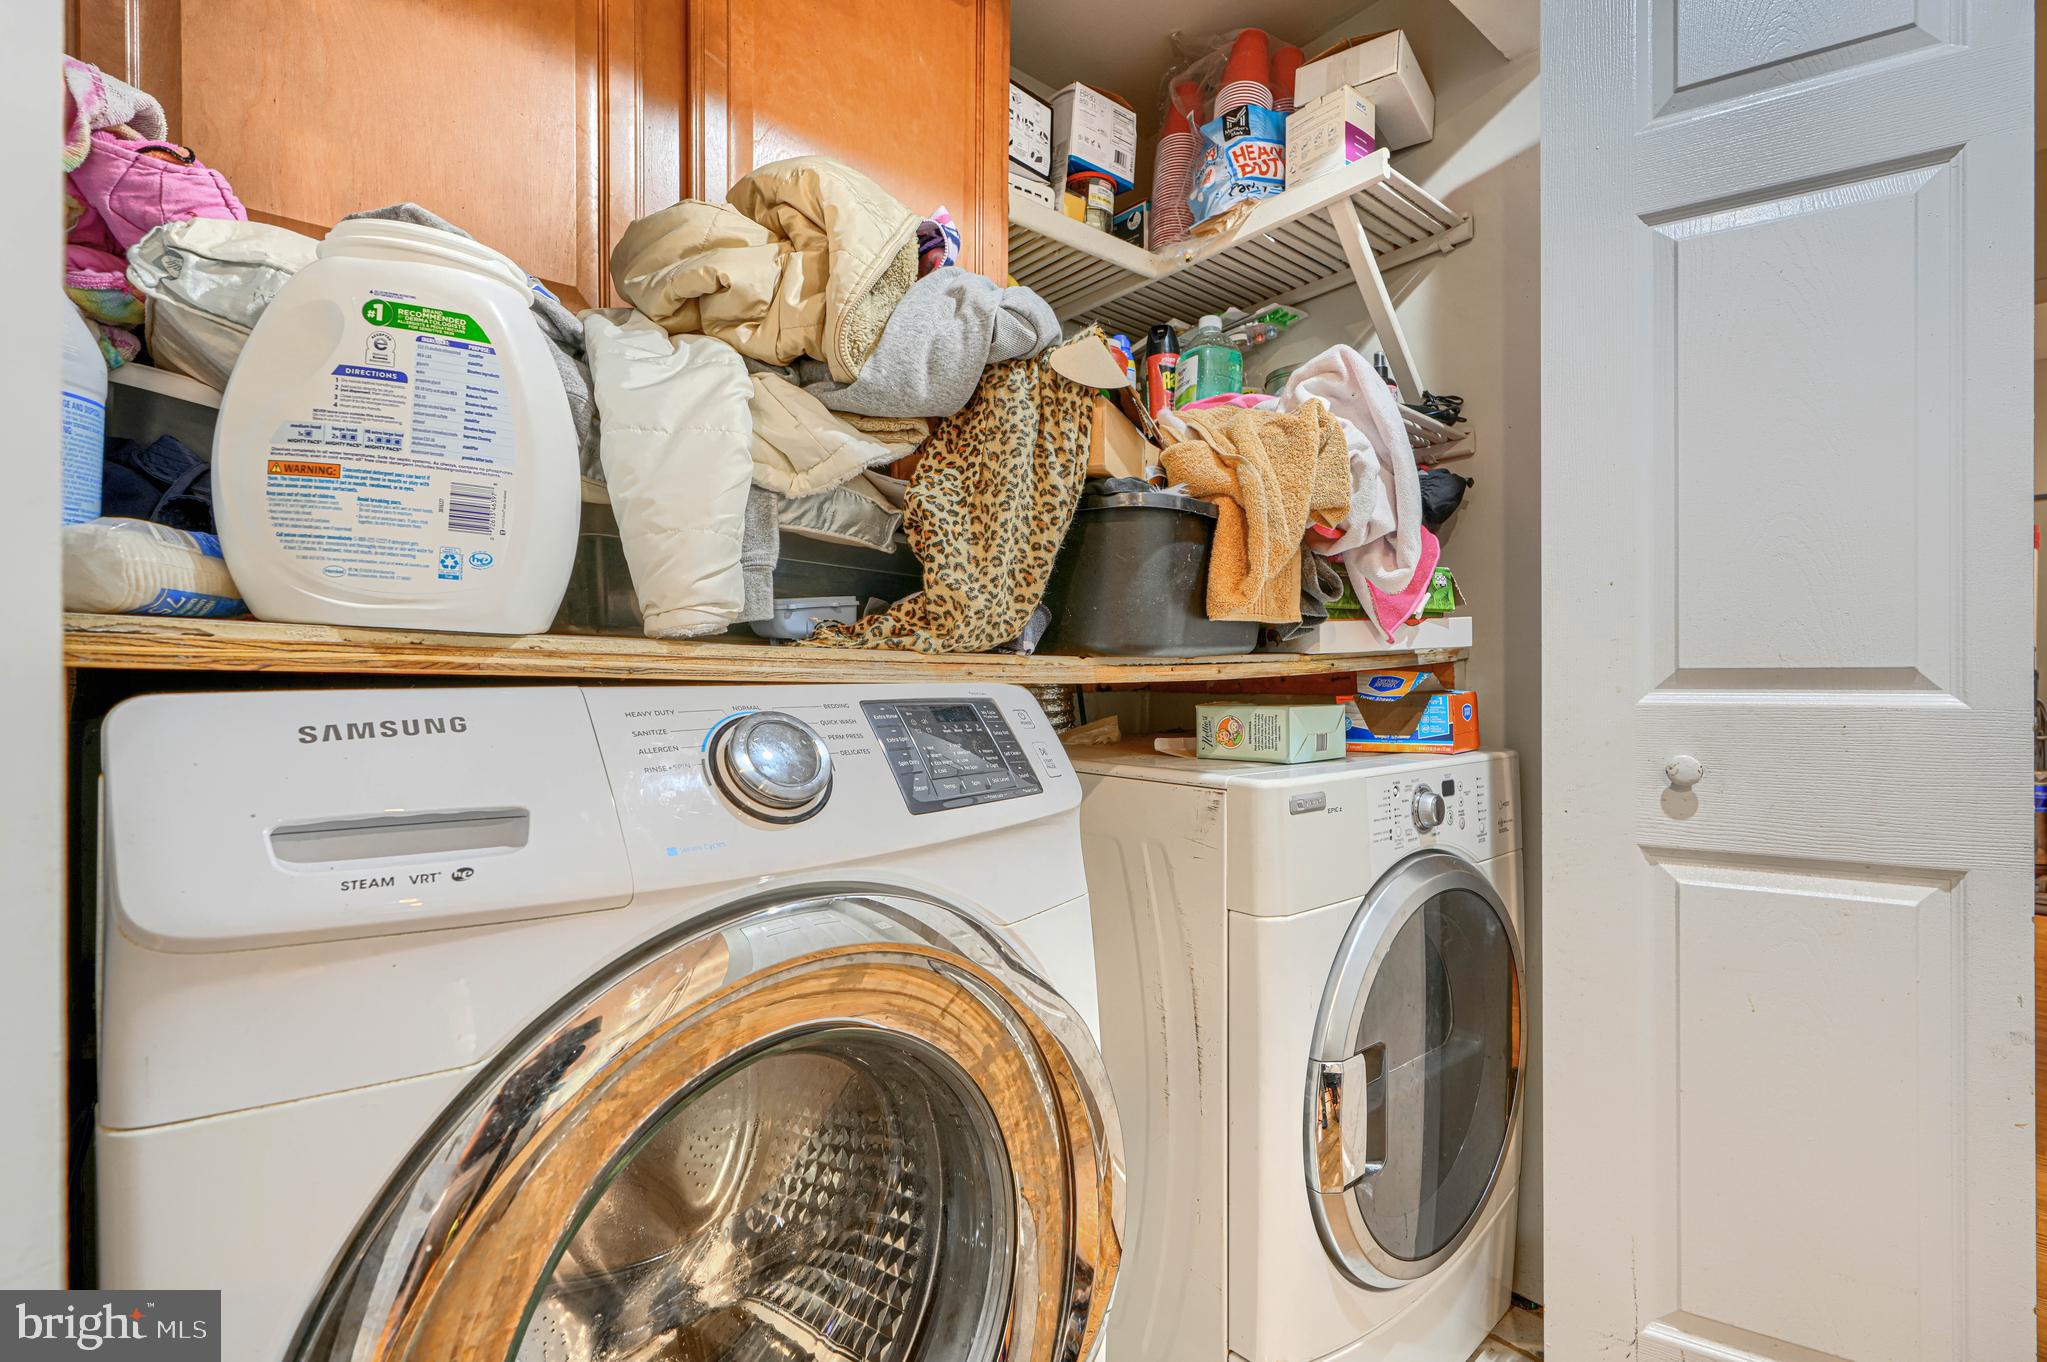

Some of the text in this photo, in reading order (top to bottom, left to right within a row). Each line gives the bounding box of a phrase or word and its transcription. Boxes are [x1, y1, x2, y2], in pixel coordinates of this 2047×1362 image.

[1237, 158, 1285, 177] DUT
[366, 303, 383, 321] #1
[398, 308, 466, 325] RECOMMENDED
[422, 308, 443, 316] BRAND
[404, 315, 466, 330] DERMATOLOGISTS
[345, 368, 398, 380] DIRECTIONS
[284, 464, 337, 477] WARNING:
[624, 709, 675, 718] HEAVY DUTY
[297, 715, 467, 744] SAMSUNG
[631, 728, 668, 738] SANITIZE
[638, 745, 679, 755] ALLERGEN
[840, 748, 870, 756] DELICATES
[643, 765, 668, 774] RINSE
[340, 877, 395, 891] STEAM
